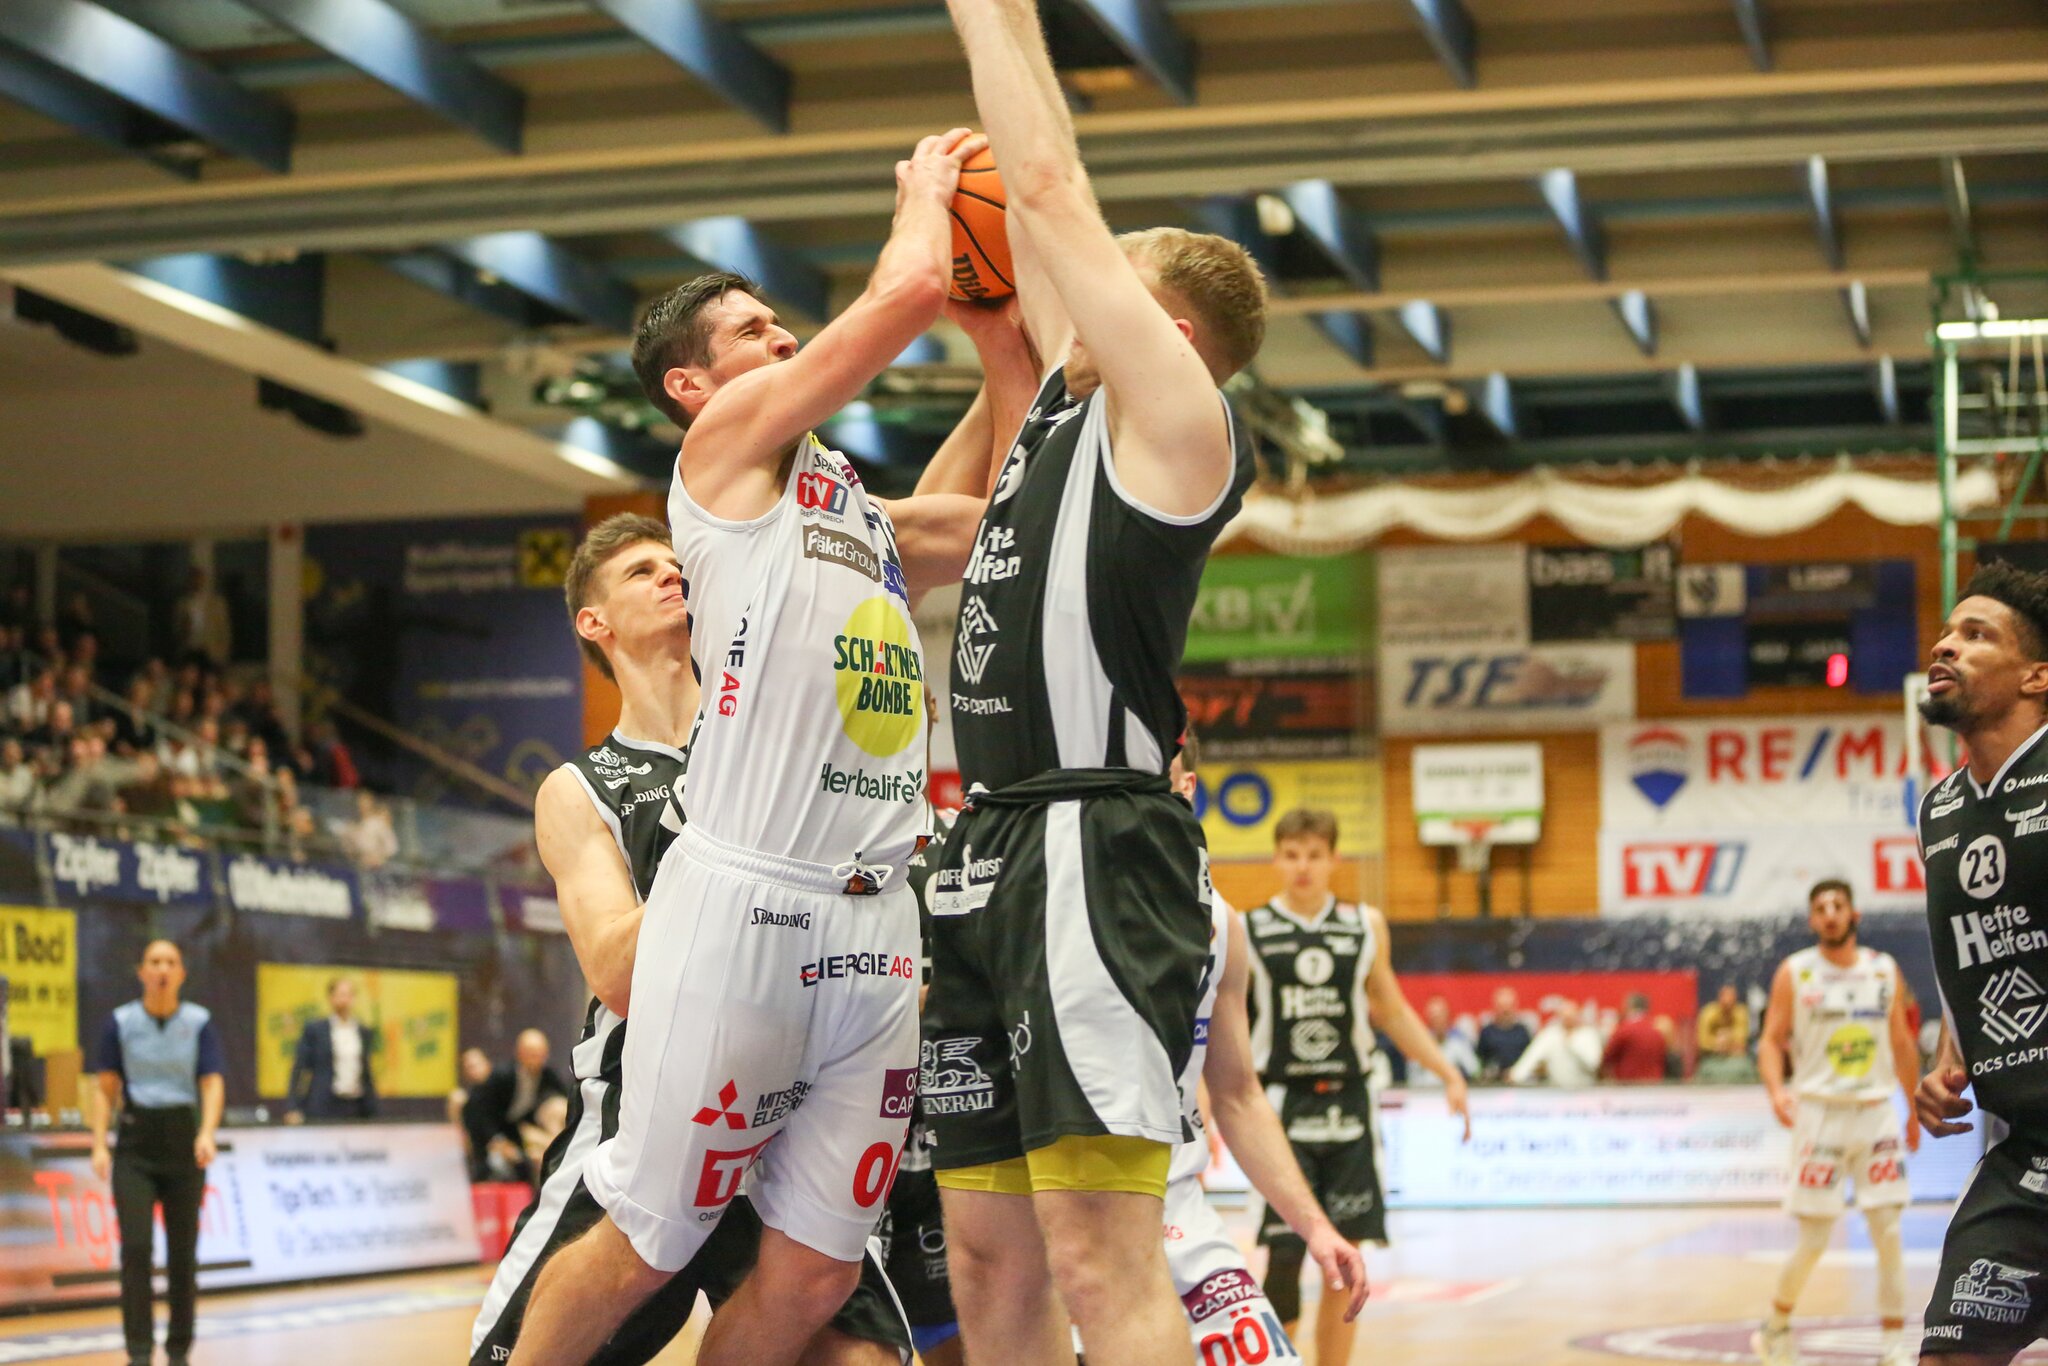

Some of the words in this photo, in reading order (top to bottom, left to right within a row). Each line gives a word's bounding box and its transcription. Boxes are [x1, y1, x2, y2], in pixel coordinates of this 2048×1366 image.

[802, 476, 845, 511] TV1
[833, 634, 923, 682] SCHARTNER
[857, 676, 913, 716] BOMBE
[1706, 726, 1968, 783] RE/MA
[821, 763, 915, 804] Herbalife
[1966, 844, 2000, 890] 23
[751, 907, 811, 931] SPALDING
[1972, 1055, 2004, 1077] OCS
[2005, 1046, 2048, 1067] CAPIT
[1202, 1272, 1242, 1295] OCS
[1191, 1284, 1264, 1319] CAPITAL
[1950, 1300, 2027, 1324] GENERALI
